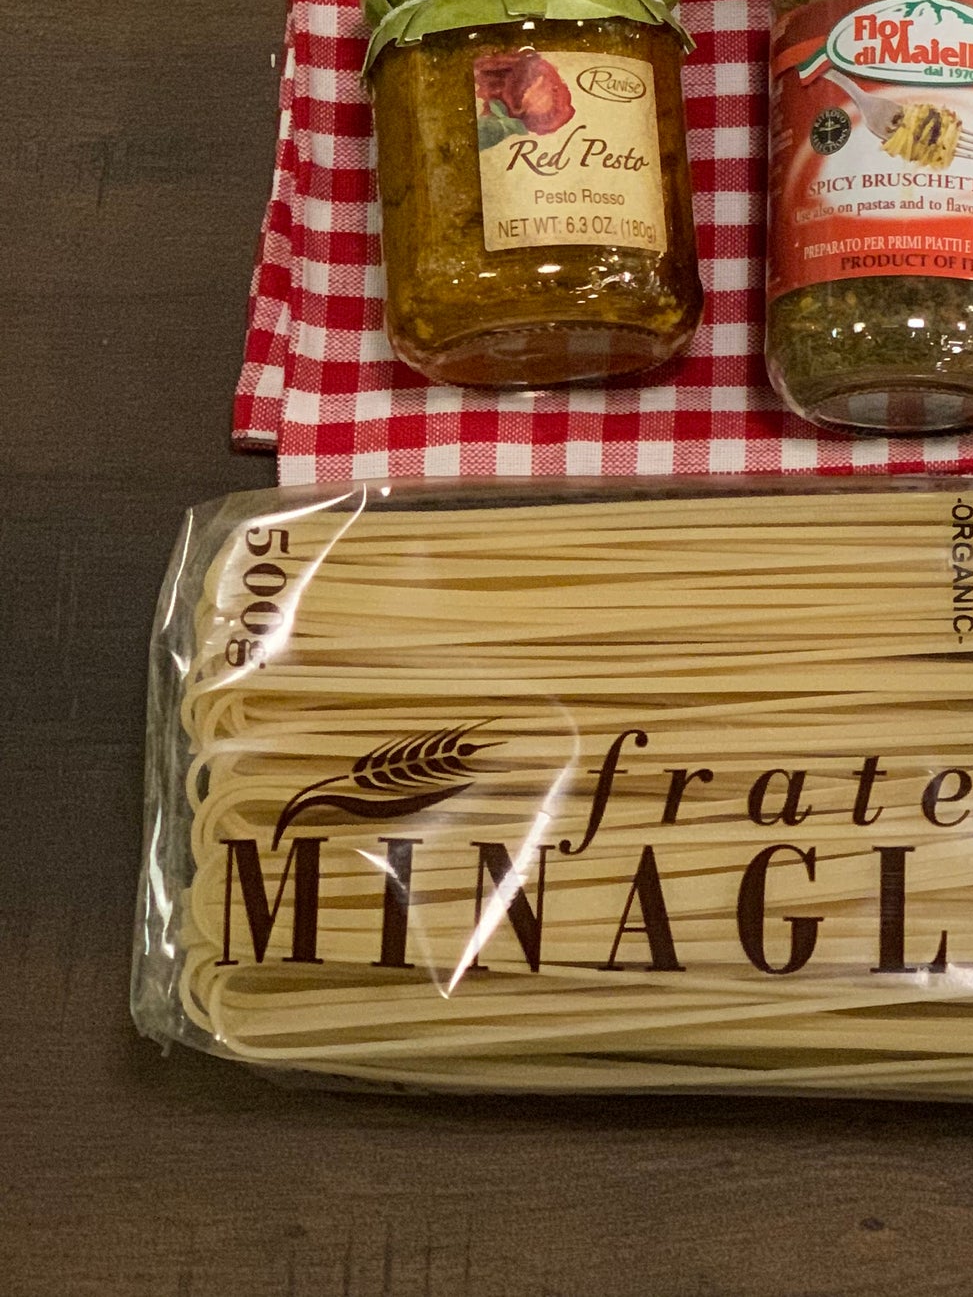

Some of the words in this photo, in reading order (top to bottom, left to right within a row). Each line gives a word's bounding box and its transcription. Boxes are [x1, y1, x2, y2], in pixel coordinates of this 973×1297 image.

[853, 13, 914, 42] Fior
[853, 46, 878, 66] di
[589, 68, 642, 94] Ranise
[923, 66, 944, 77] dal
[506, 124, 588, 177] Red
[580, 137, 650, 172] Pesto
[534, 189, 578, 205] Pesto
[582, 189, 626, 205] Rosso
[808, 174, 858, 198] SPICY
[813, 203, 835, 218] also
[837, 203, 853, 213] on
[857, 200, 896, 216] pastas
[900, 196, 925, 210] and
[929, 200, 942, 211] to
[499, 217, 529, 238] NET
[533, 217, 562, 234] WT.
[566, 217, 588, 234] 6.3
[592, 216, 618, 235] OZ.
[620, 221, 656, 243] (180g)
[803, 237, 862, 260] PREPARATO
[864, 237, 885, 251] PER
[888, 236, 922, 250] PRIMI
[925, 237, 962, 252] PIATTI
[964, 240, 972, 253] E
[840, 253, 929, 271] PRODUCT
[933, 255, 958, 269] OF
